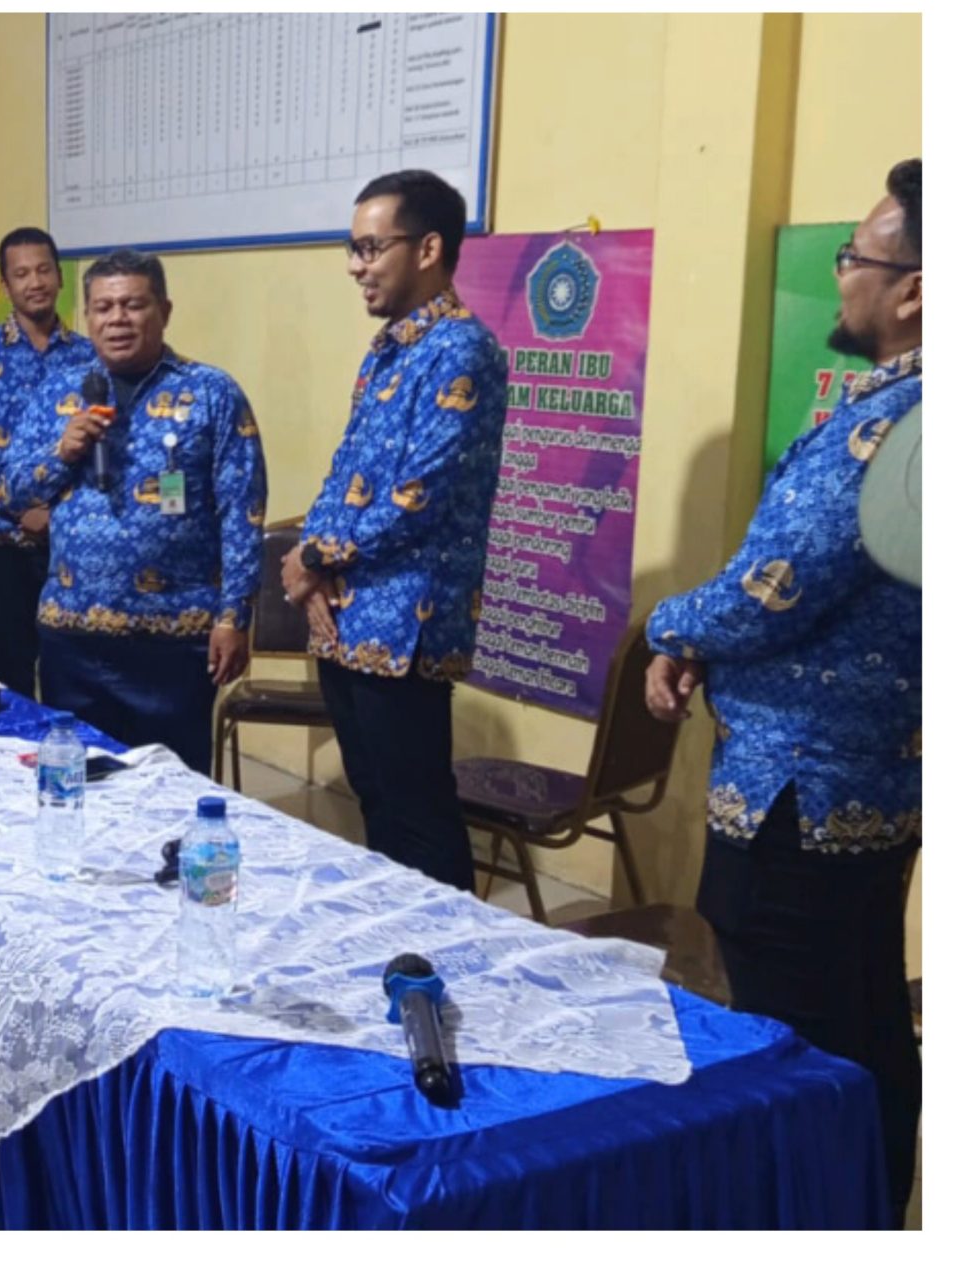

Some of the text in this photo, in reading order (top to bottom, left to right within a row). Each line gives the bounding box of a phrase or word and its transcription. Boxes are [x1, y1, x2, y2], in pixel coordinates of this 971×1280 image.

[514, 348, 574, 376] PERAN
[579, 350, 614, 380] IBU
[816, 370, 834, 398] 7
[536, 384, 636, 419] KELUARGA
